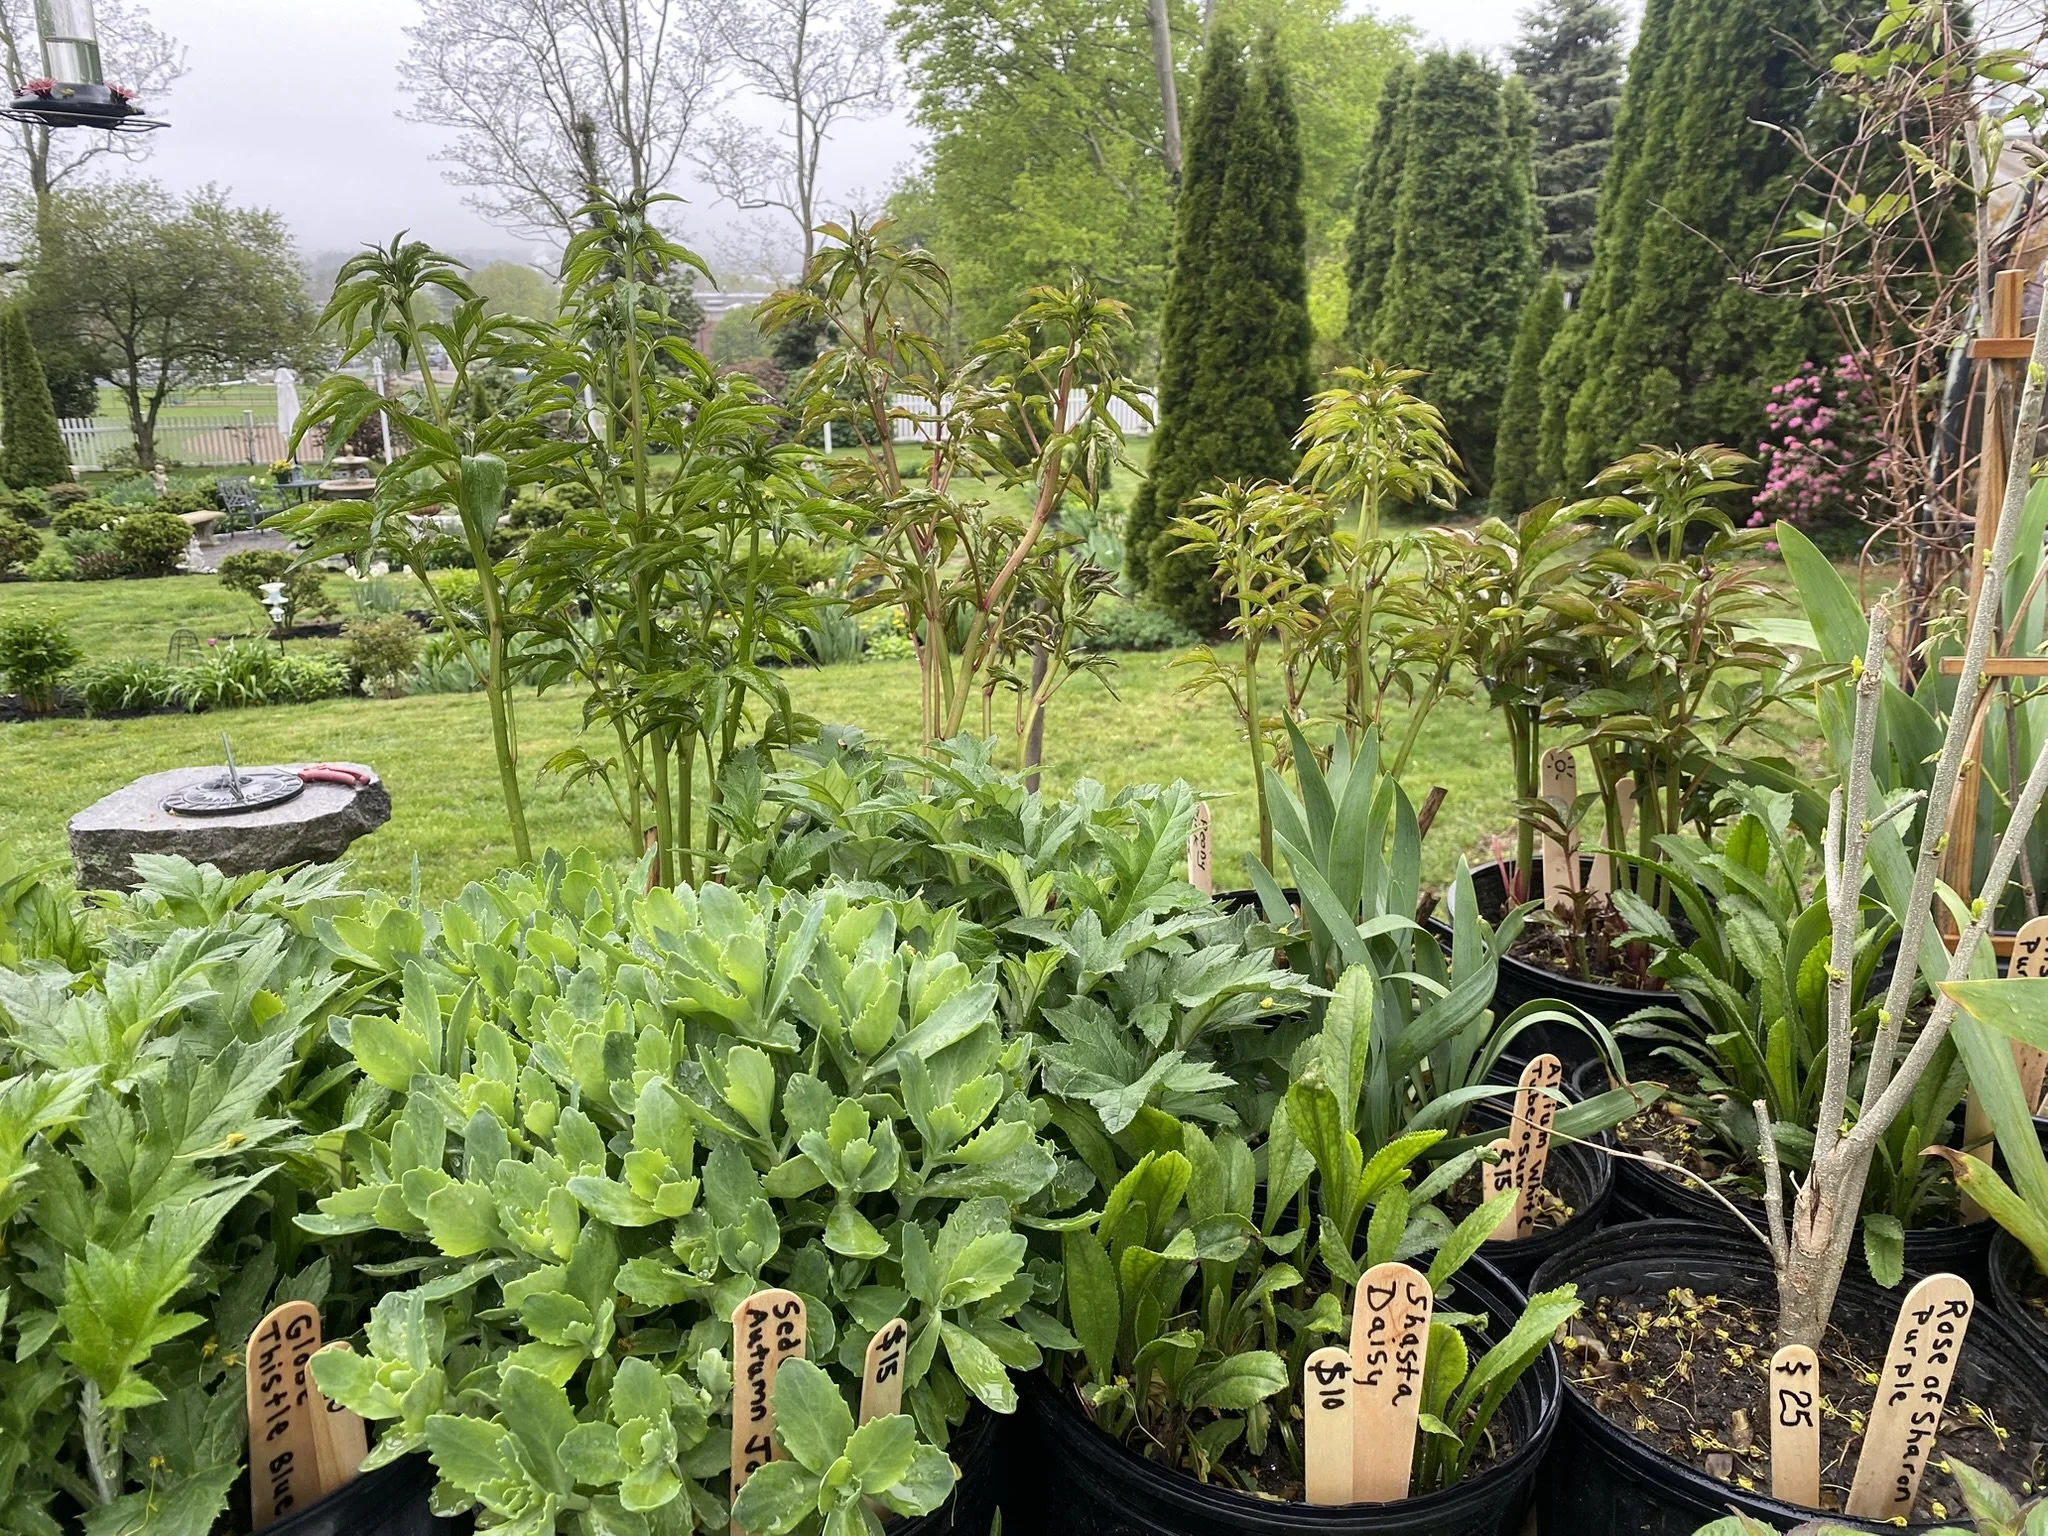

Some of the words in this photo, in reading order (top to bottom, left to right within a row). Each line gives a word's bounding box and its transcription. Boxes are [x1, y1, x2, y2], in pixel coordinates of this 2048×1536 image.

[1518, 1159, 1542, 1229] White
[746, 1308, 770, 1422] Autumn
[772, 1300, 802, 1369] Sed
[875, 1324, 907, 1384] $15
[1353, 1280, 1398, 1387] Daisy
[1391, 1281, 1428, 1408] Shasta
[1888, 1304, 1936, 1408] Purple
[1927, 1299, 1969, 1366] Rose
[258, 1320, 292, 1442] Thistle
[1307, 1359, 1352, 1411] $10
[1921, 1374, 1943, 1405] of
[269, 1450, 295, 1517] Blue
[1893, 1410, 1937, 1503] Sharon
